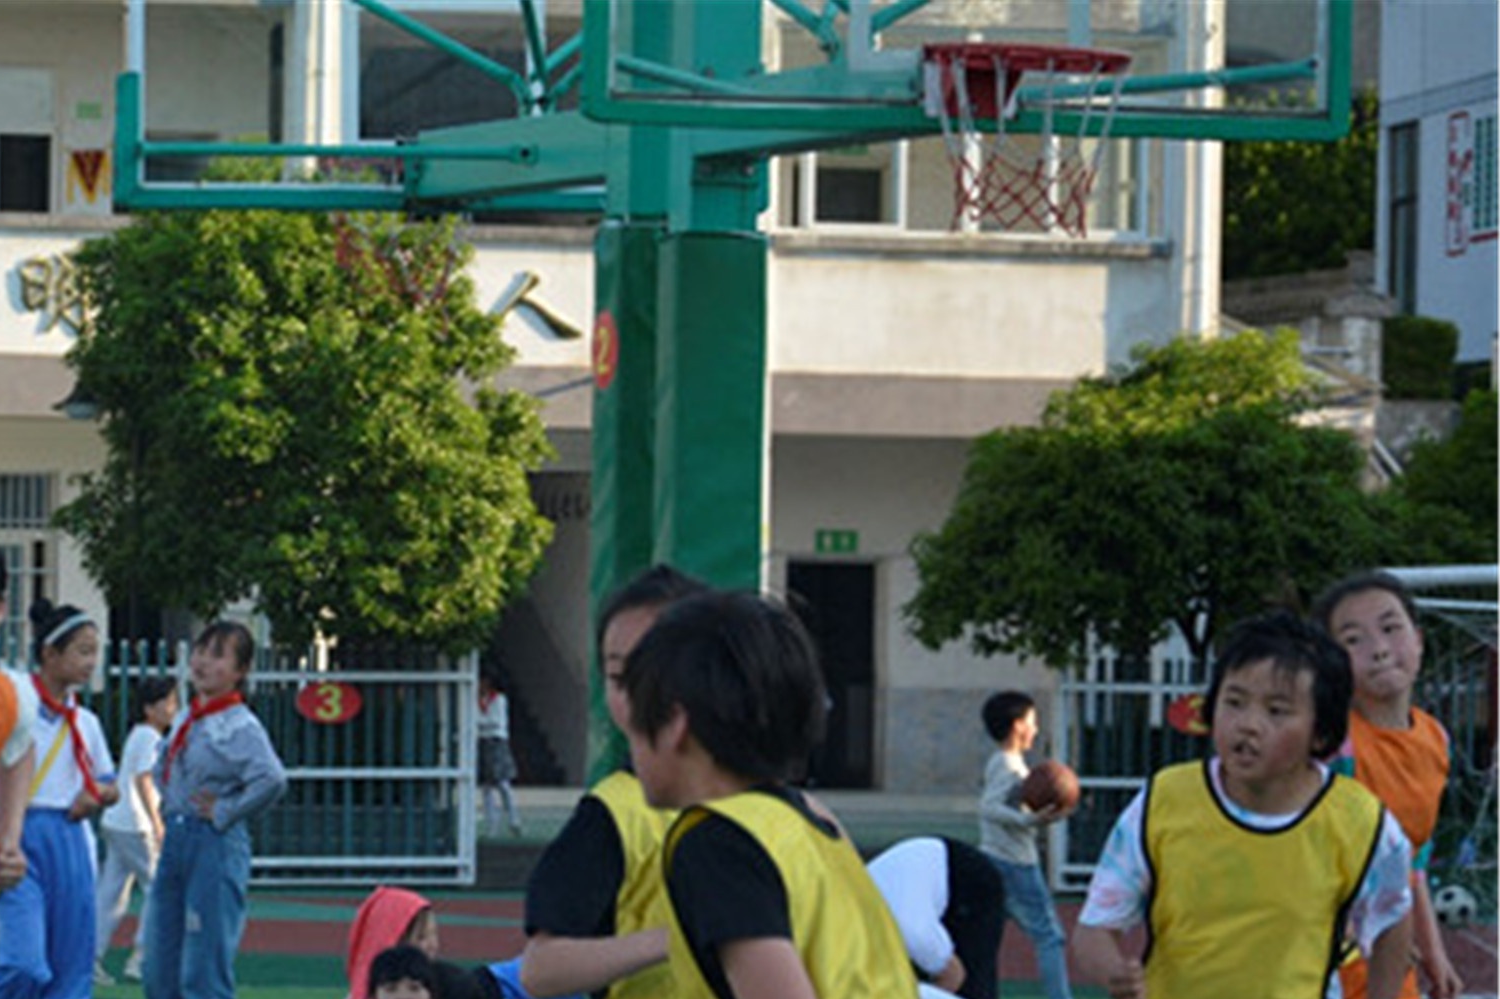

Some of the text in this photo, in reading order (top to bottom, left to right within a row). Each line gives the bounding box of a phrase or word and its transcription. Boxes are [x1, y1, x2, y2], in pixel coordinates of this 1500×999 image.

[497, 270, 583, 340] 人
[597, 326, 611, 373] 2
[315, 683, 343, 720] 3
